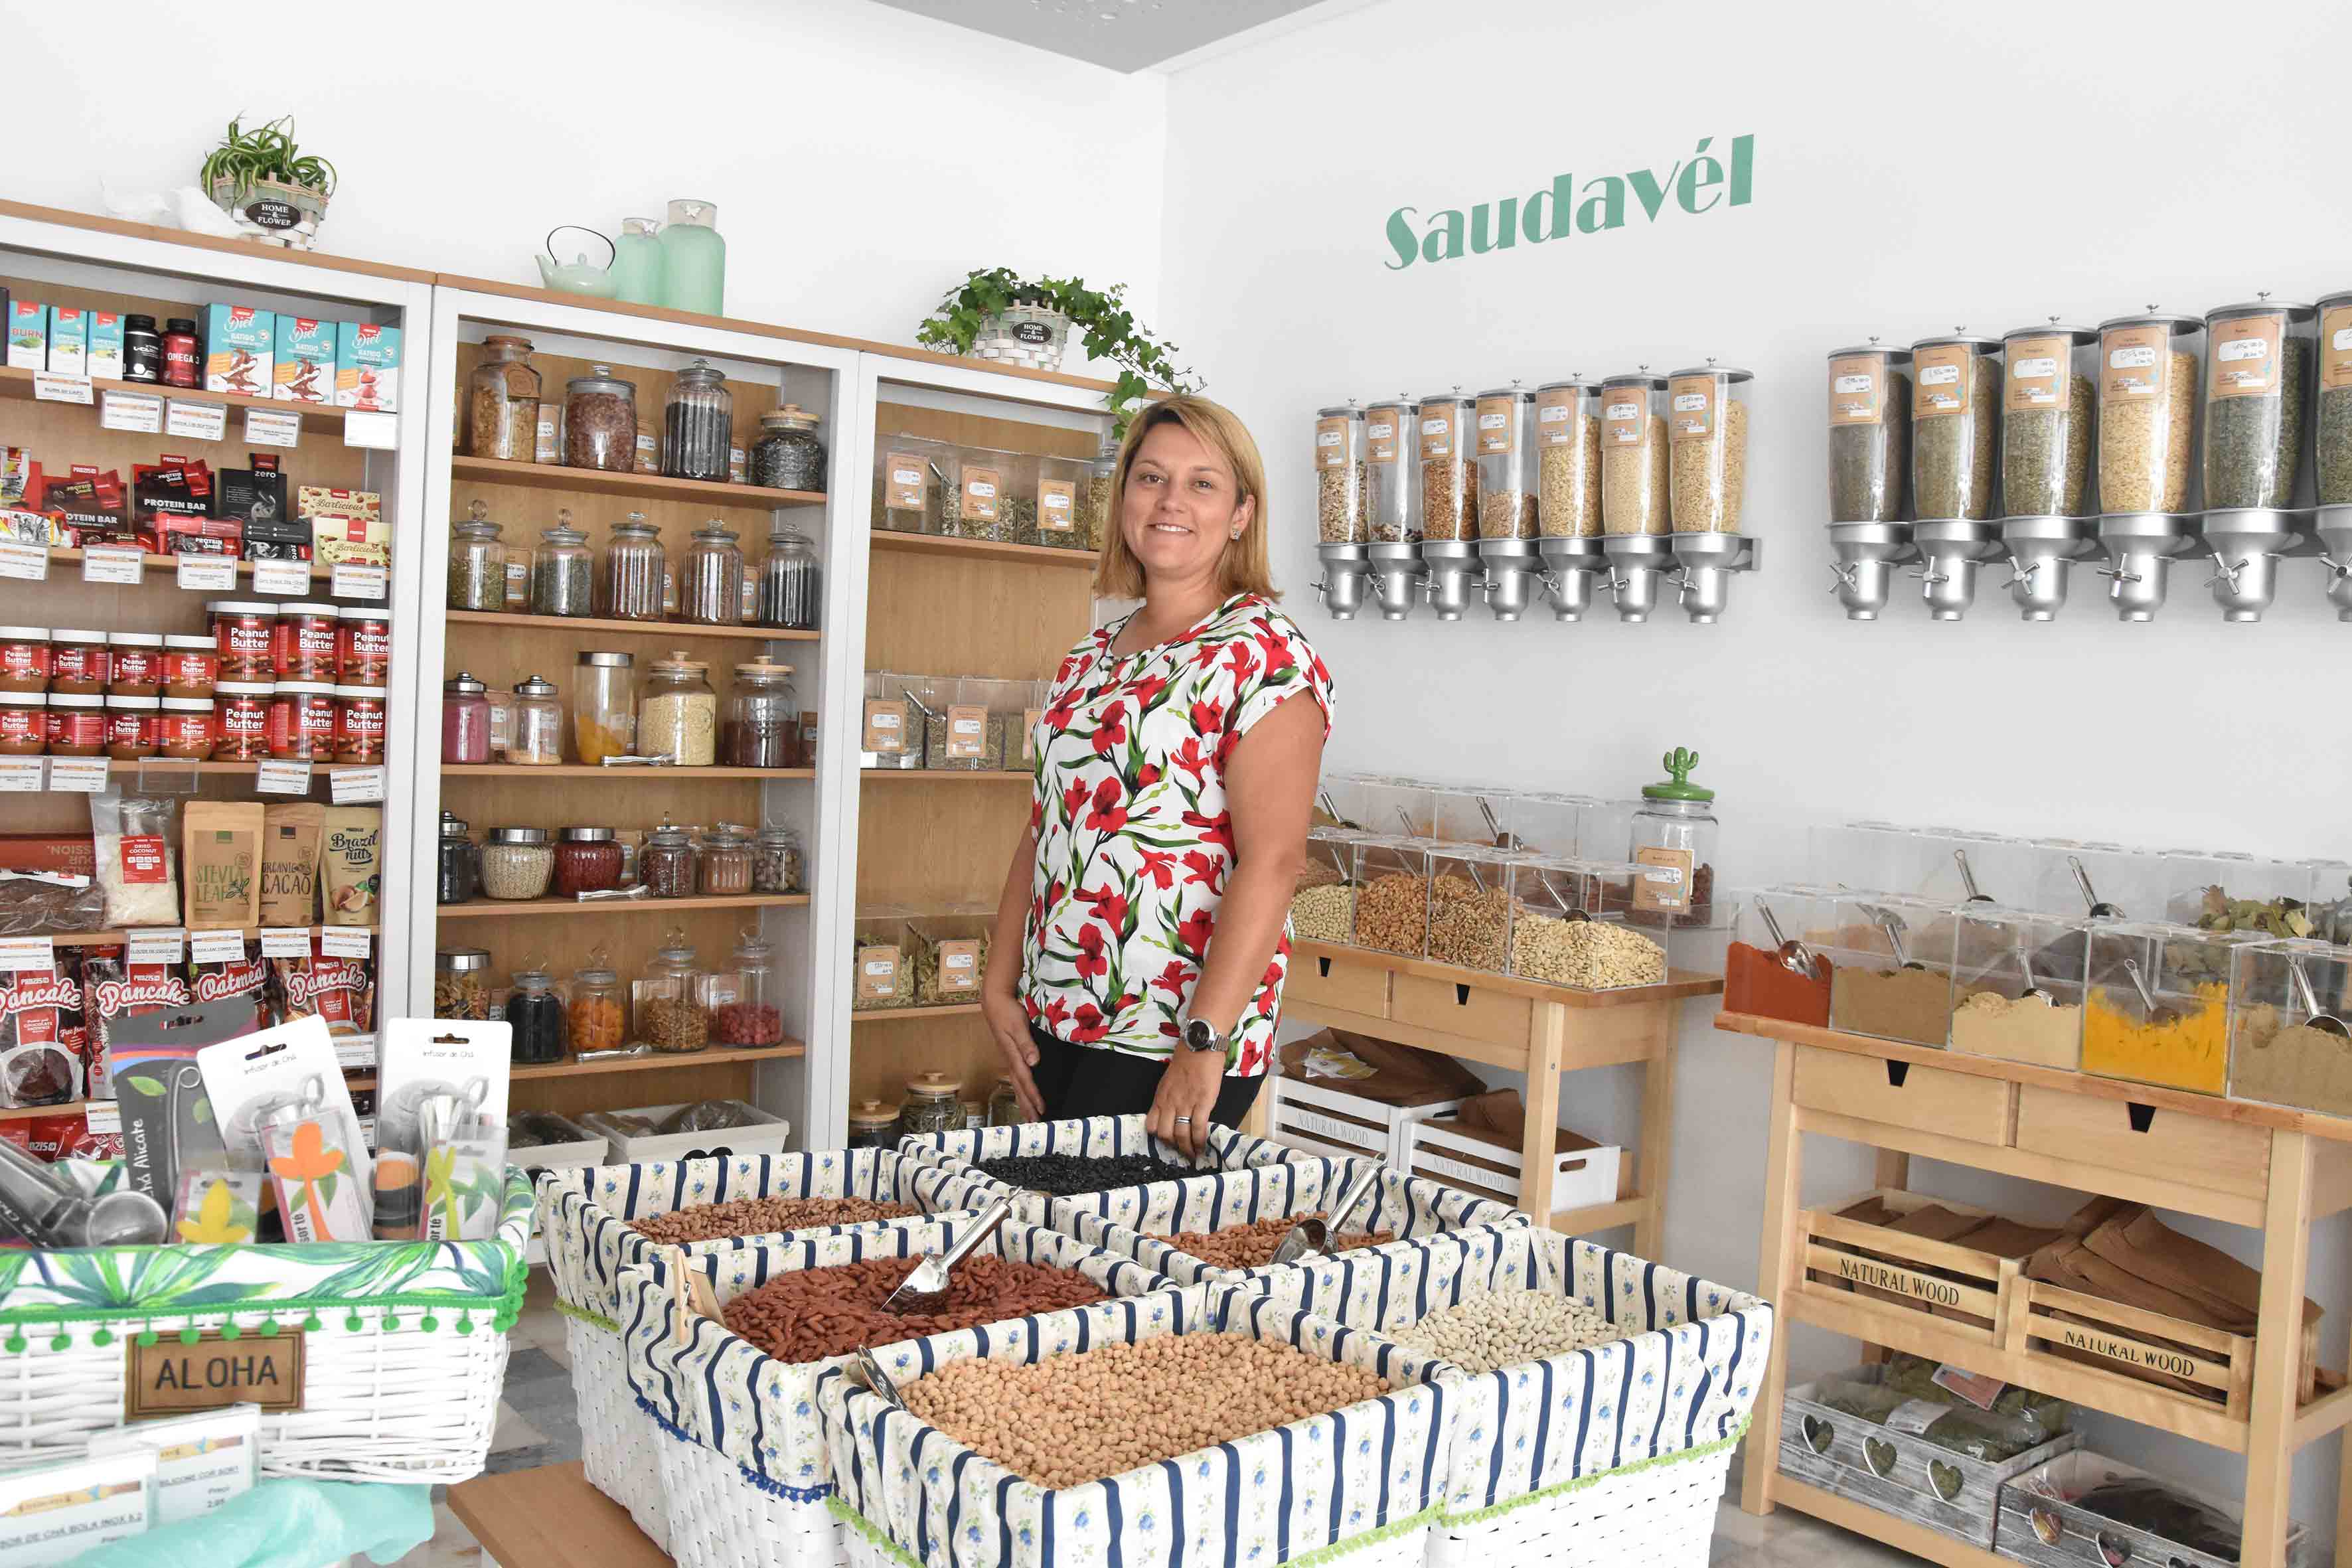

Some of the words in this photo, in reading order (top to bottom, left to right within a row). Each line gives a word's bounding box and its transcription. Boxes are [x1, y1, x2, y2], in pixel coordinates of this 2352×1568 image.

[1384, 133, 1755, 270] Saudavél
[262, 204, 289, 213] HOME
[258, 216, 291, 226] FLOWER
[224, 313, 256, 332] Diet
[12, 328, 43, 339] BURN
[289, 325, 321, 343] Diet
[352, 331, 382, 349] Diet
[167, 352, 194, 364] OMEGA
[195, 356, 200, 364] 3
[144, 499, 185, 509] PROTEIN
[187, 502, 206, 510] BAR
[66, 513, 96, 523] OTEIN
[98, 515, 118, 524] BAR
[231, 627, 269, 639] Peanut
[299, 629, 335, 639] Peanut
[354, 632, 388, 642] Peanut
[231, 637, 269, 648] Butter
[299, 639, 334, 650] Butter
[354, 641, 388, 652] Butter
[226, 708, 264, 719] Peanut
[301, 708, 333, 718] Peanut
[347, 710, 383, 720] Peanut
[226, 718, 264, 730] Butter
[301, 717, 333, 728] Butter
[347, 720, 383, 730] Butter
[330, 830, 378, 851] Brazil
[346, 847, 372, 862] nuts
[196, 865, 244, 884] STEVIA
[261, 876, 311, 895] CACAO
[196, 886, 226, 902] LEAF
[292, 966, 363, 1003] Pancake
[102, 982, 191, 1010] Pancake
[1296, 1113, 1338, 1137] NATURAL
[1340, 1124, 1369, 1146] WOOD
[129, 1118, 151, 1168] Alicate
[1433, 1158, 1473, 1182] NATURAL
[1475, 1168, 1504, 1190] WOOD
[1839, 1258, 1909, 1293] NATURAL
[1912, 1277, 1959, 1306] WOOD
[2064, 1331, 2140, 1362] NATURAL
[2144, 1351, 2195, 1376] WOOD
[155, 1356, 278, 1391] ALOHA
